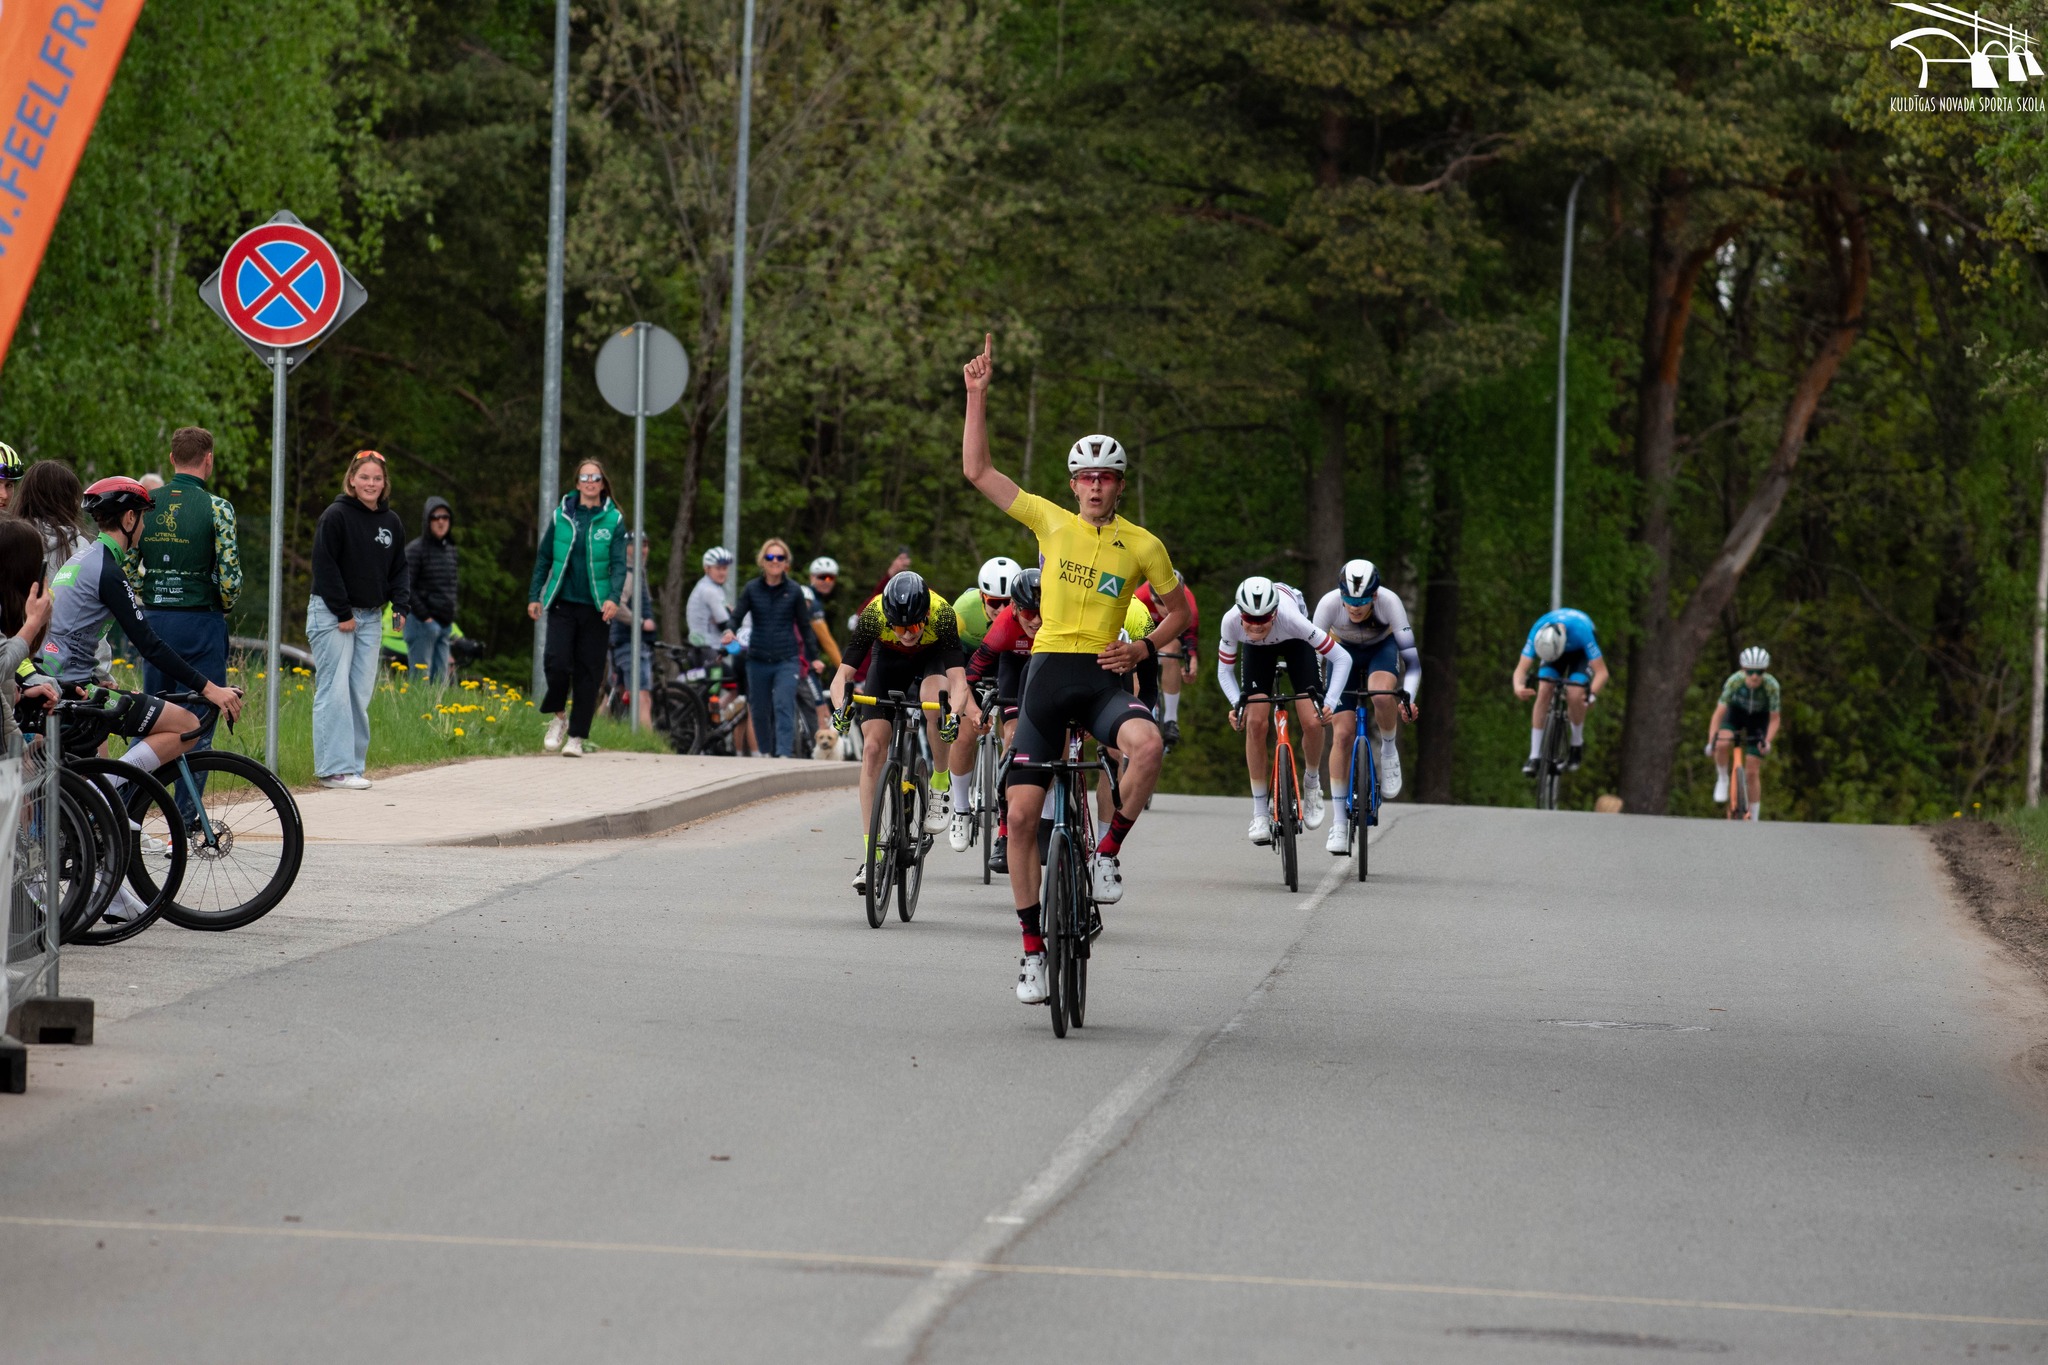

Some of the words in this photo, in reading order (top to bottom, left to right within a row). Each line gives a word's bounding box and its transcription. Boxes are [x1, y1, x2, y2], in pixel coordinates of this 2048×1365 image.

[0, 0, 105, 256] .FEELFR
[1059, 558, 1098, 579] VERTE
[1059, 571, 1094, 589] AUTO
[137, 705, 156, 732] OSHEE
